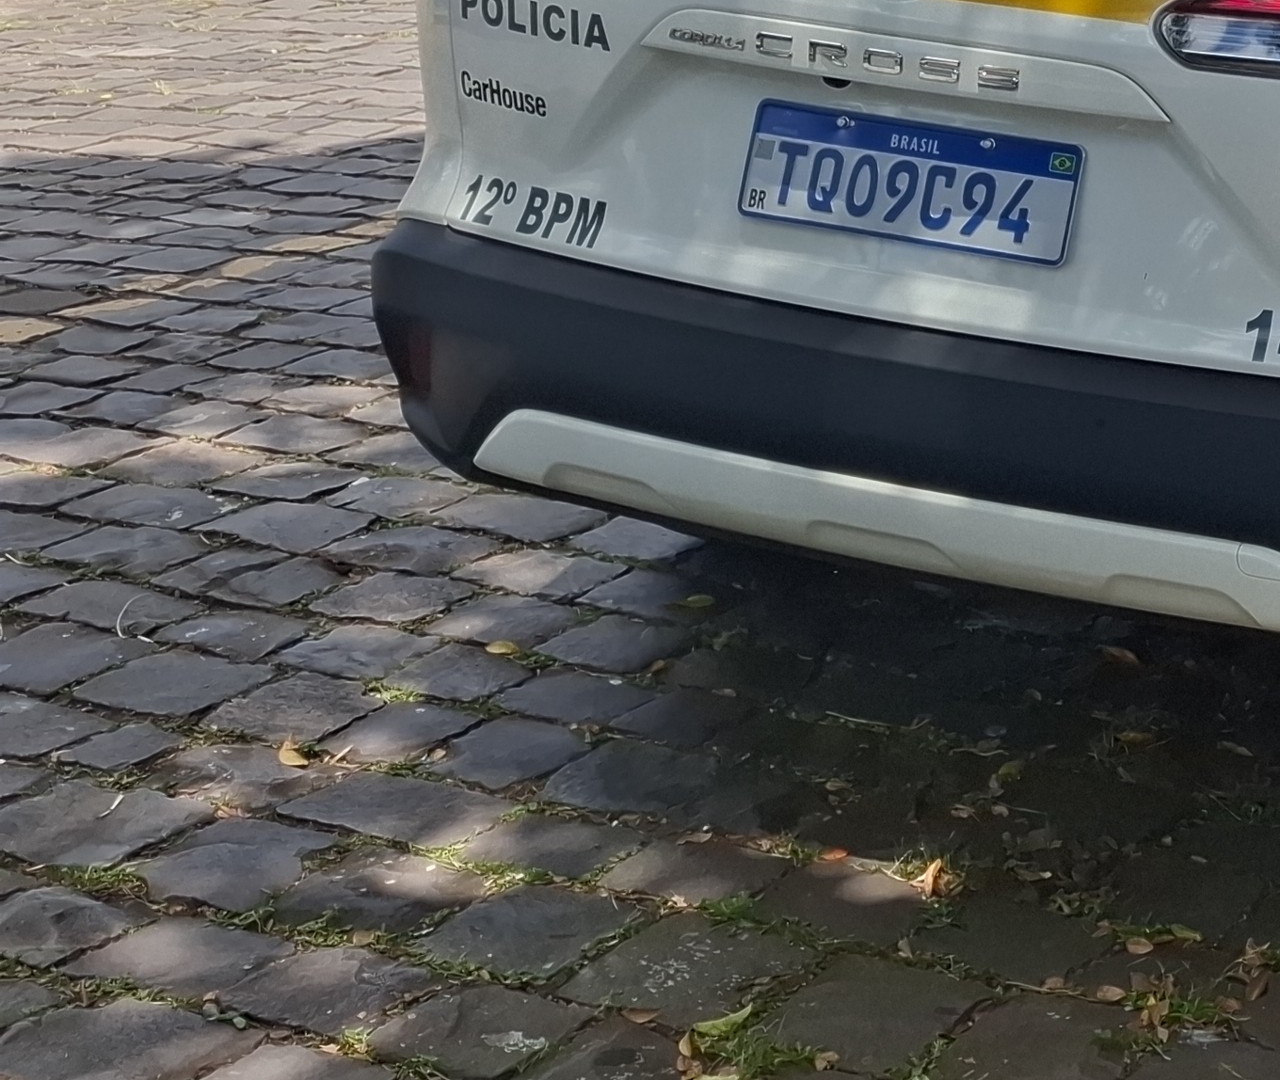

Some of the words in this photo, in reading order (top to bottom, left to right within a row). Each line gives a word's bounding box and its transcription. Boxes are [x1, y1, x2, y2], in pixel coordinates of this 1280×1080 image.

[755, 31, 1020, 90] CROSS
[460, 70, 548, 117] CarHouse
[890, 133, 941, 155] BRASIL
[515, 185, 608, 249] BPM
[748, 188, 767, 211] BR
